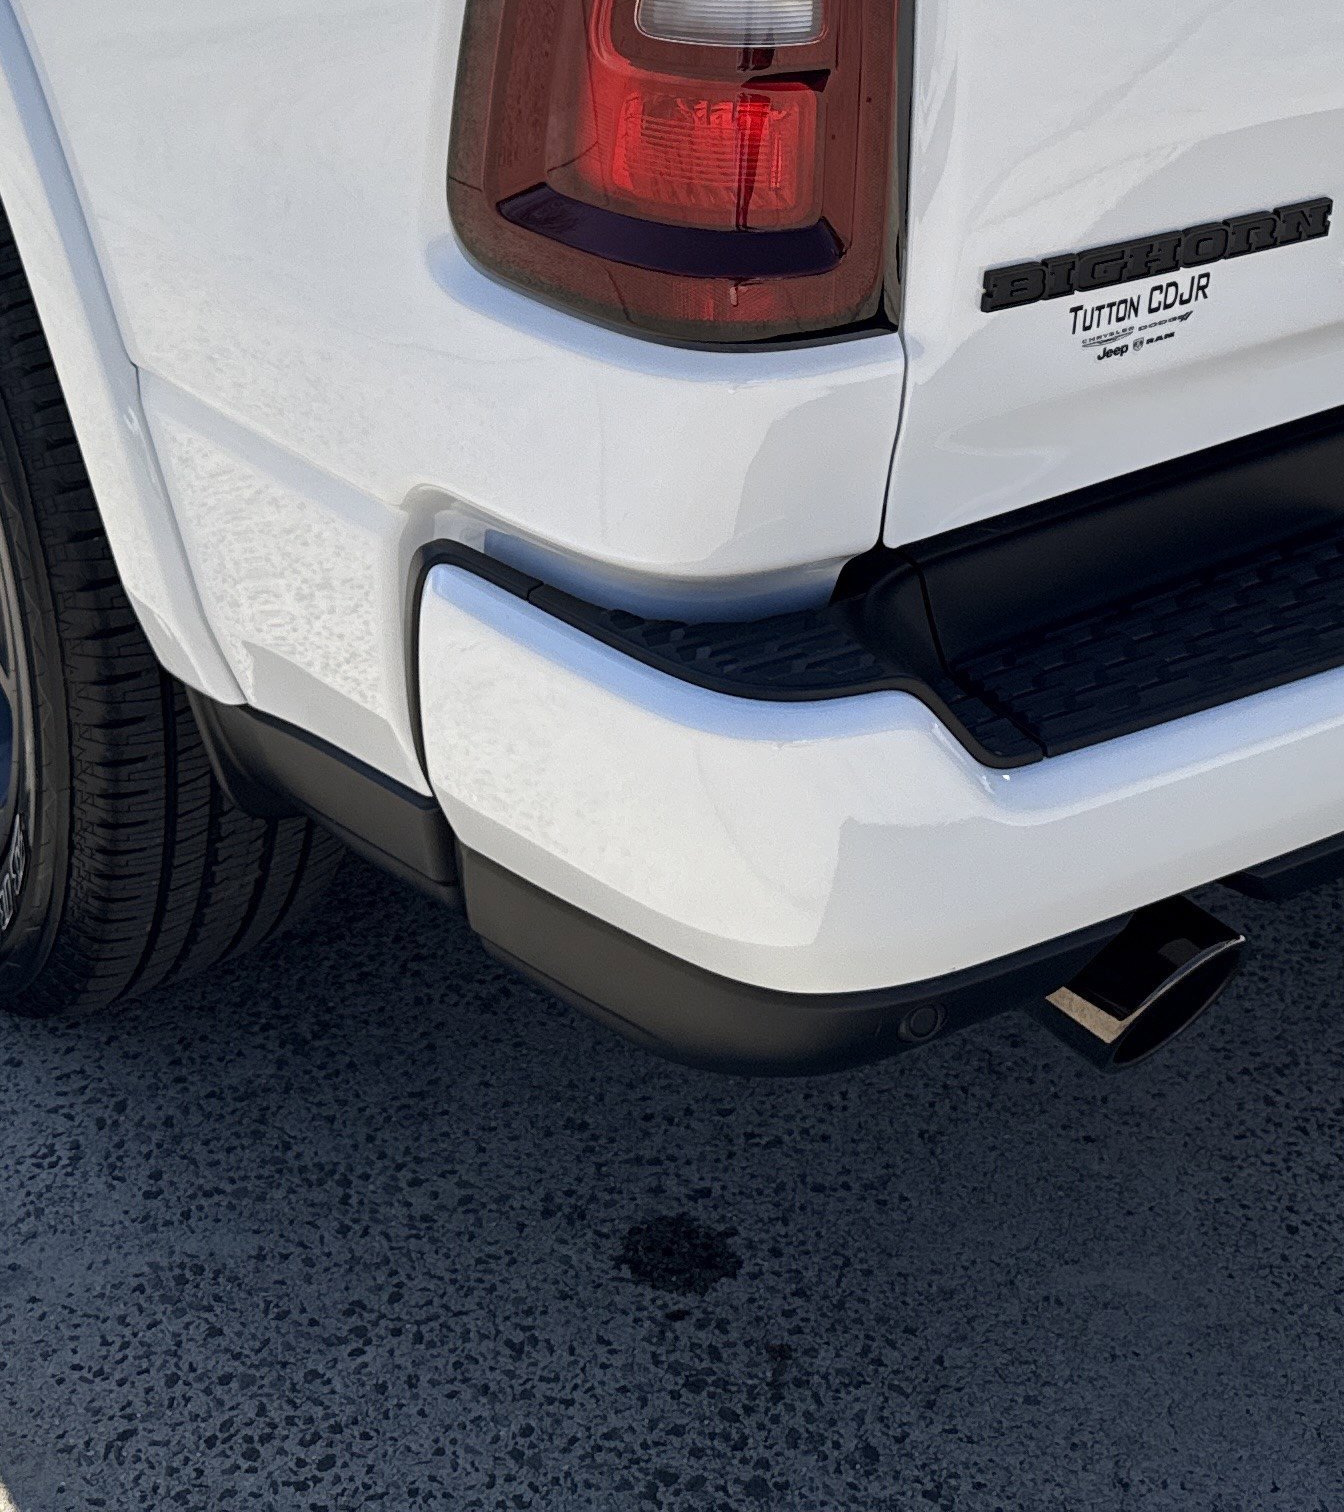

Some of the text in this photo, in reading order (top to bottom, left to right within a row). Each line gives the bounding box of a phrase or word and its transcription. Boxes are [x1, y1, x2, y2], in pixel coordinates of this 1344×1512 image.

[980, 196, 1333, 313] BIGHORN
[1069, 272, 1211, 335] TUTTON CDJR
[1081, 326, 1135, 344] CHRYSLER
[1097, 332, 1175, 361] Jeep RAM
